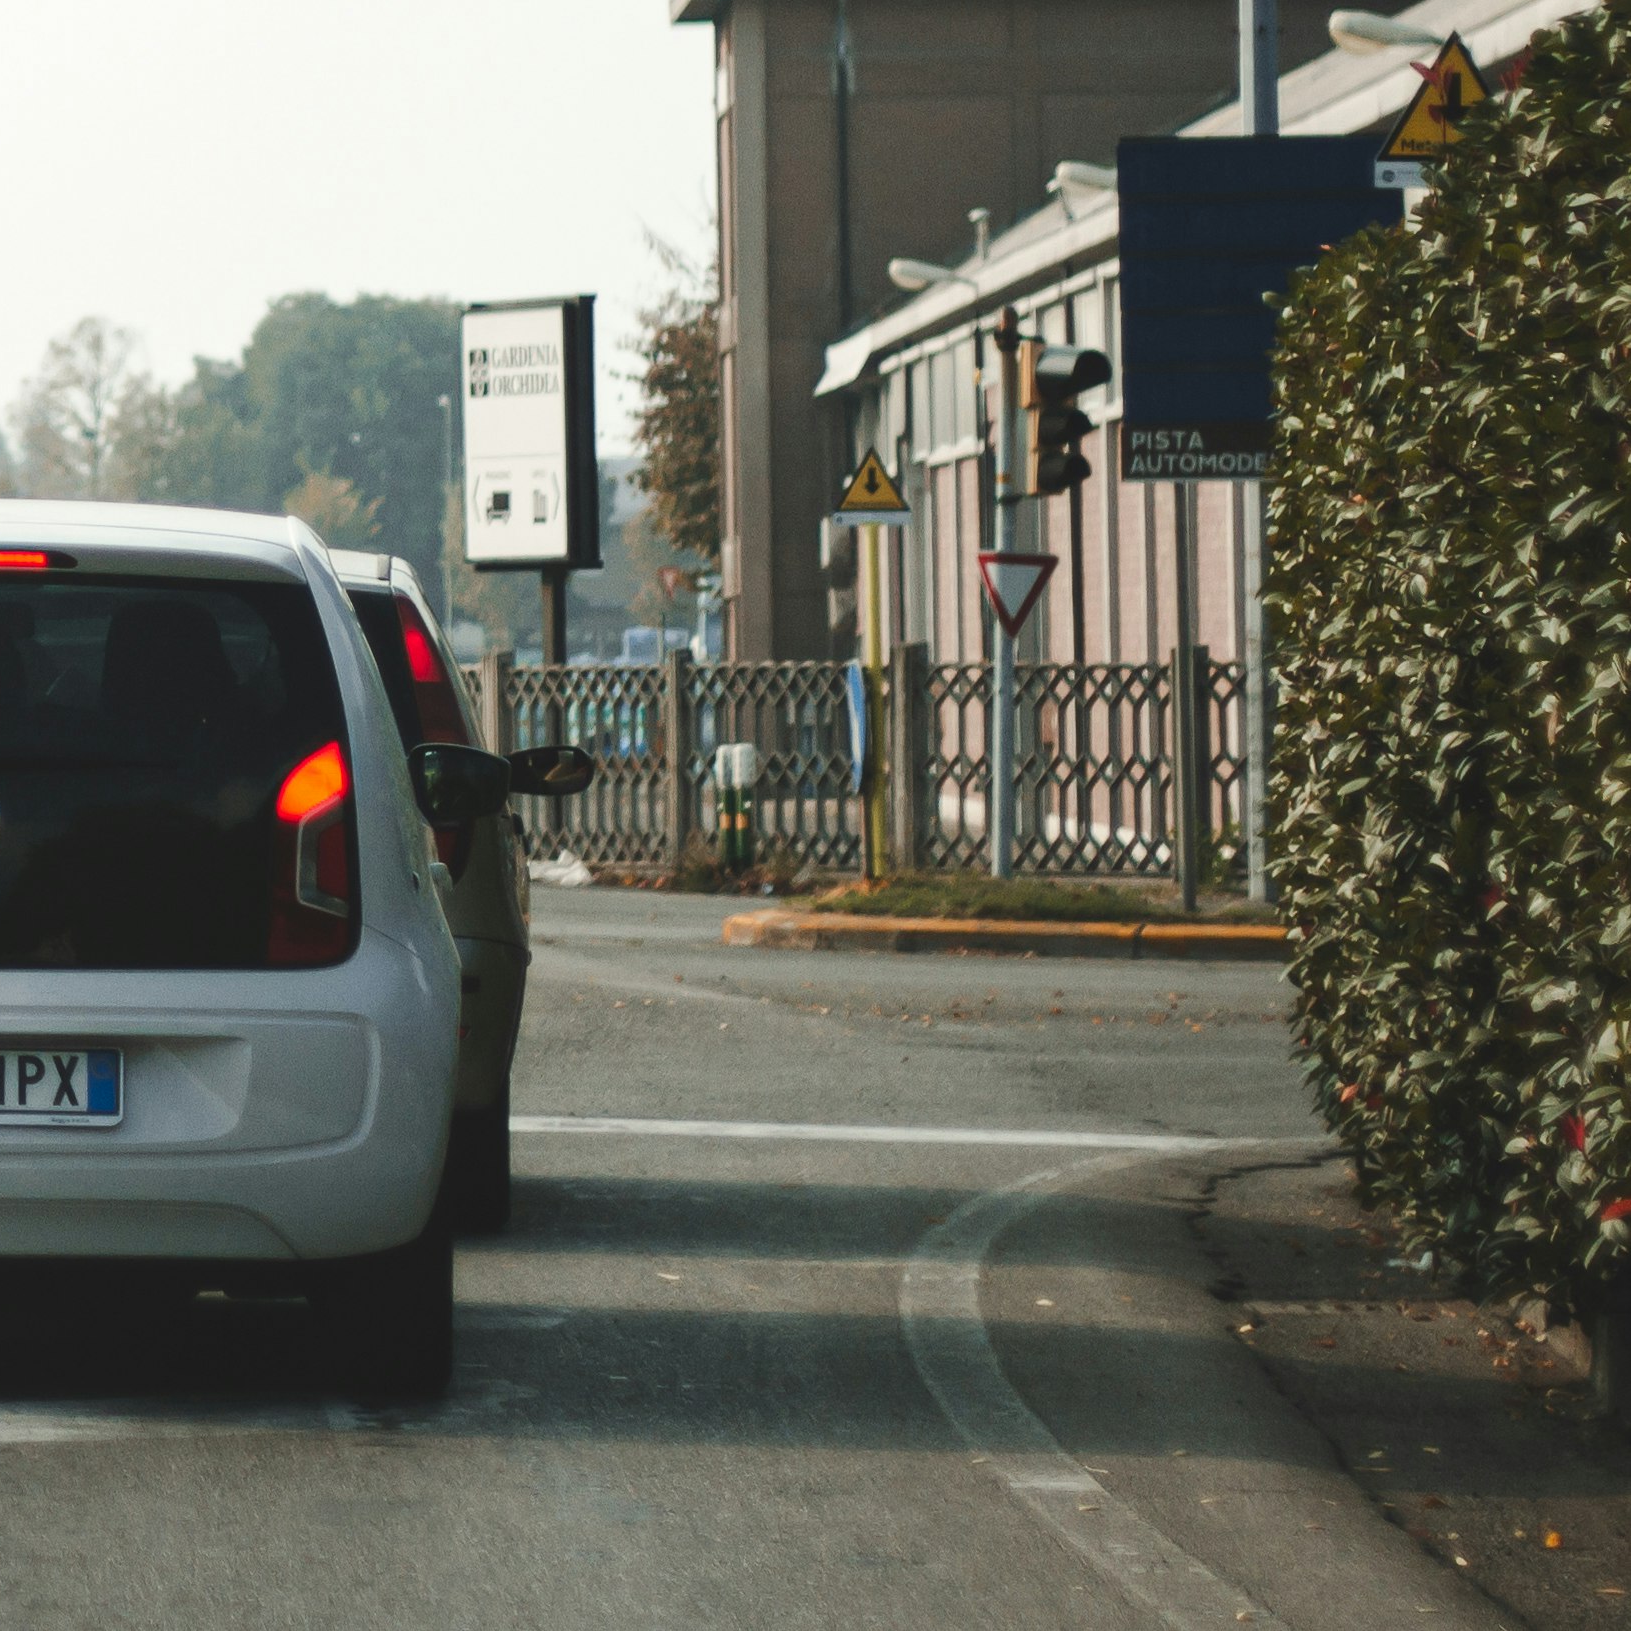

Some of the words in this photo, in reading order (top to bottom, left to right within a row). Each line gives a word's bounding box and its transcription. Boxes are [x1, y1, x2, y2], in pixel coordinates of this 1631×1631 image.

[491, 344, 560, 368] GARDENIA
[492, 372, 560, 397] ORCHIDEA
[1131, 430, 1204, 451] PISTA
[1130, 453, 1275, 475] AUTOMODE
